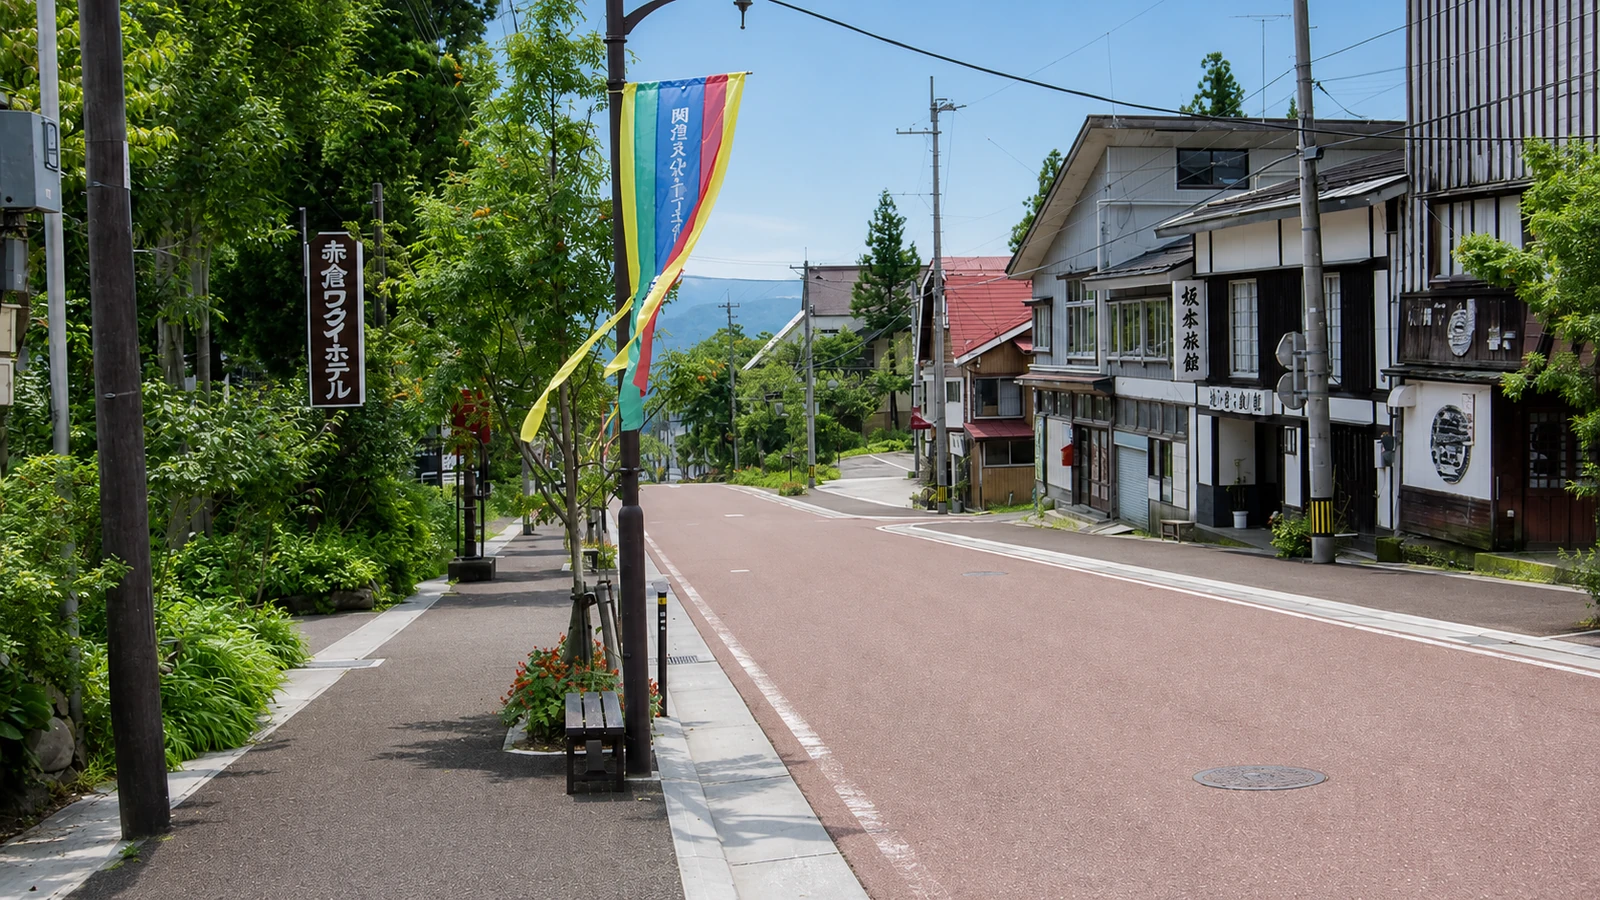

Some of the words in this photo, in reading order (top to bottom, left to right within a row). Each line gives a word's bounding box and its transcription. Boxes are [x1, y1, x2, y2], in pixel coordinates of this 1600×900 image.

[320, 239, 352, 401] 赤倉ワクイホテル
[1181, 285, 1200, 373] 坂本旅館
